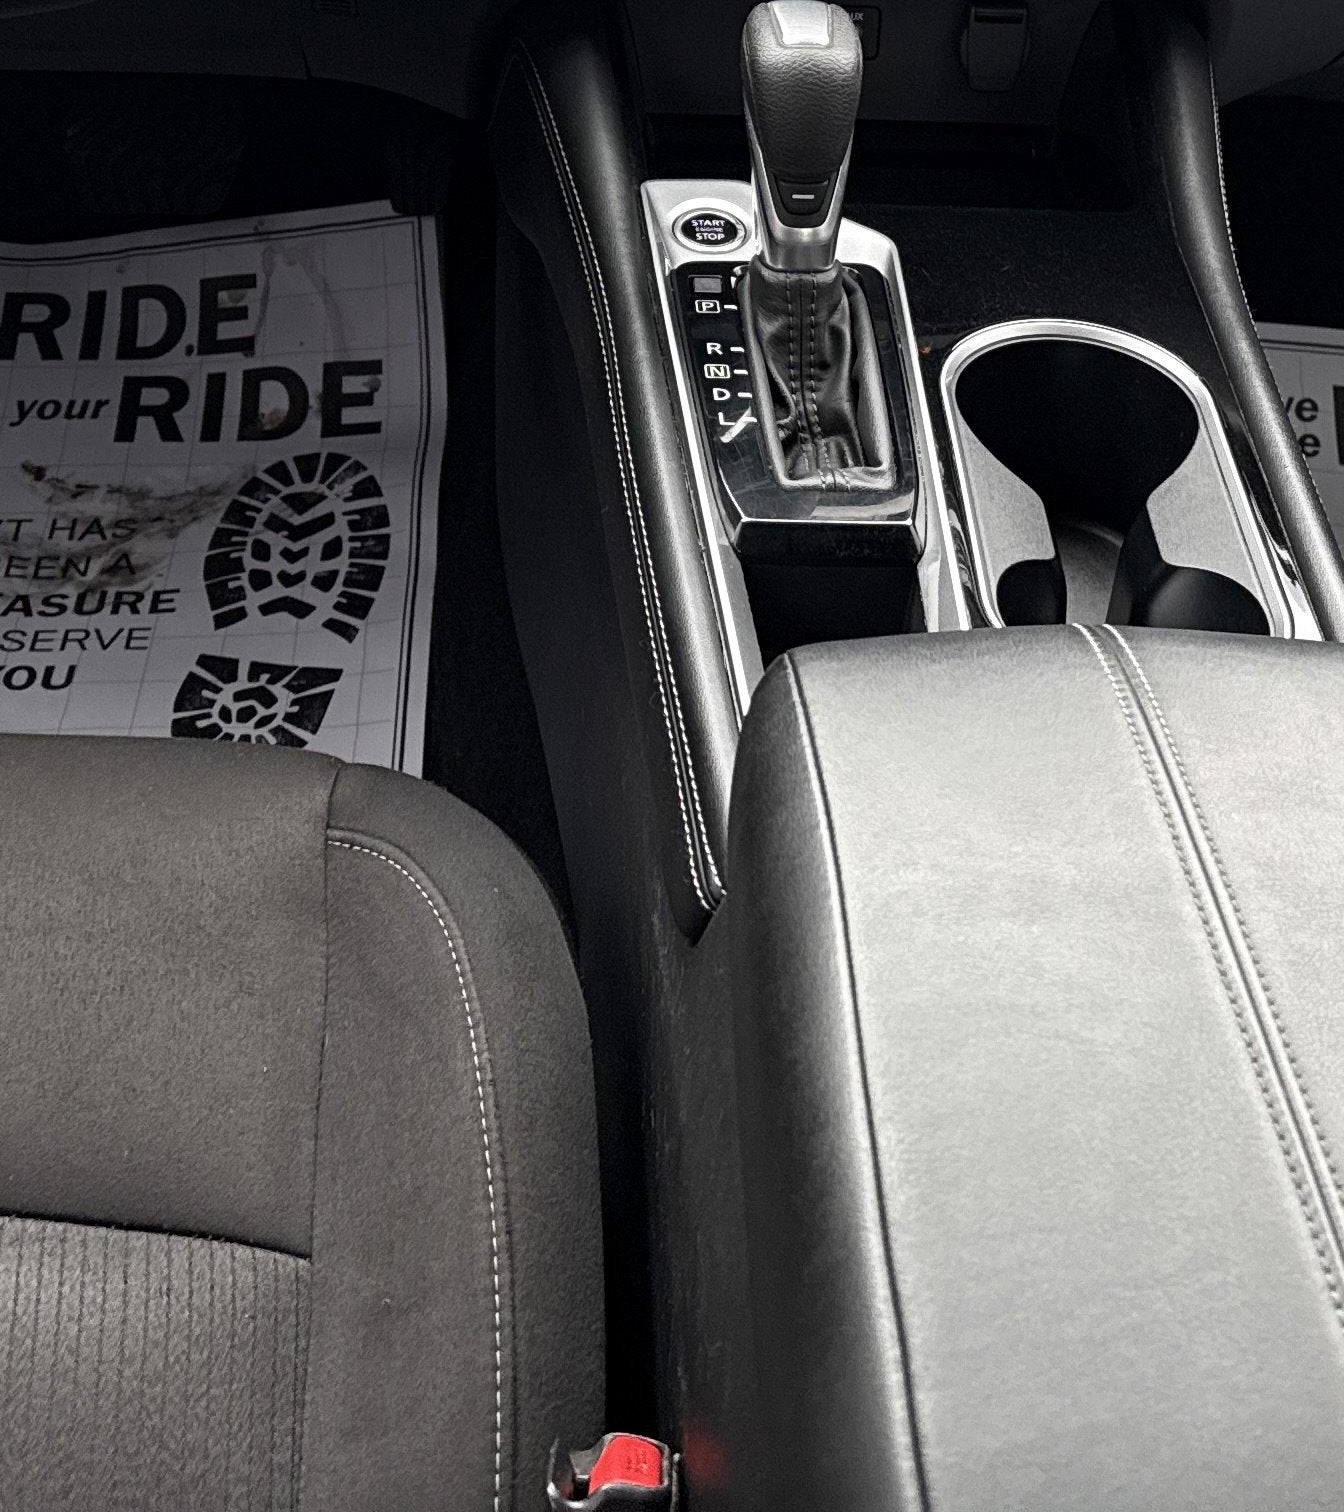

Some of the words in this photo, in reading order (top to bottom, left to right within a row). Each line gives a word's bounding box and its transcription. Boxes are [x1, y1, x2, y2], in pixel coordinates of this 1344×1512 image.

[691, 218, 725, 227] START
[695, 232, 725, 241] STOP
[705, 342, 723, 355] R
[9, 394, 111, 428] your
[112, 358, 383, 443] RIDE
[712, 387, 731, 401] D
[717, 411, 736, 425] L
[46, 516, 137, 542] HAS
[103, 553, 137, 578] A
